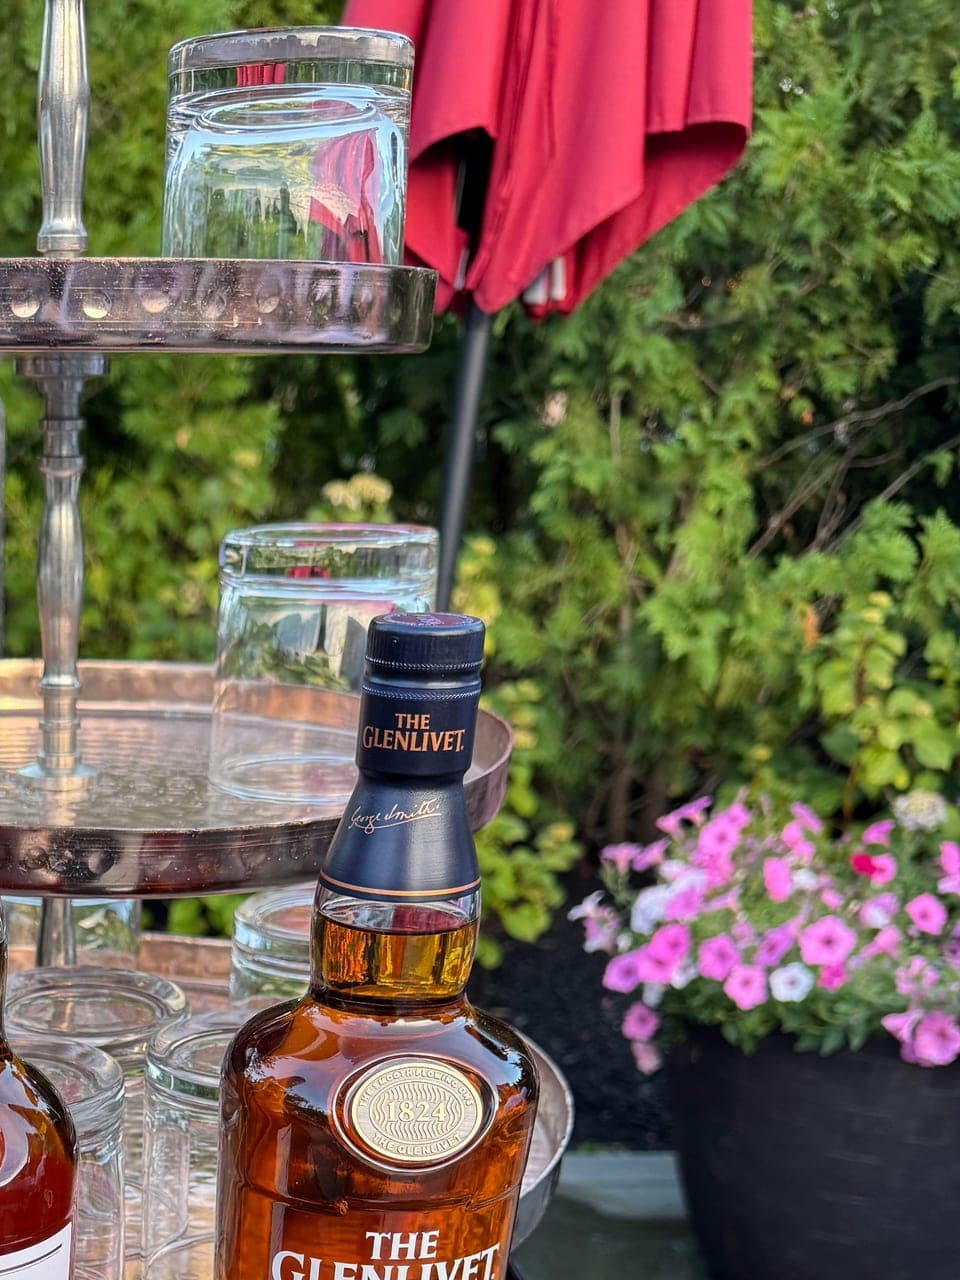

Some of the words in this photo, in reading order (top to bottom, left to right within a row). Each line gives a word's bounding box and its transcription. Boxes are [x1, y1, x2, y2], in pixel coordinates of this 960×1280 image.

[395, 713, 430, 729] THE
[362, 727, 465, 753] GLENLIVET
[387, 1101, 447, 1123] 1824
[373, 1132, 396, 1151] THE
[365, 1230, 440, 1261] THE
